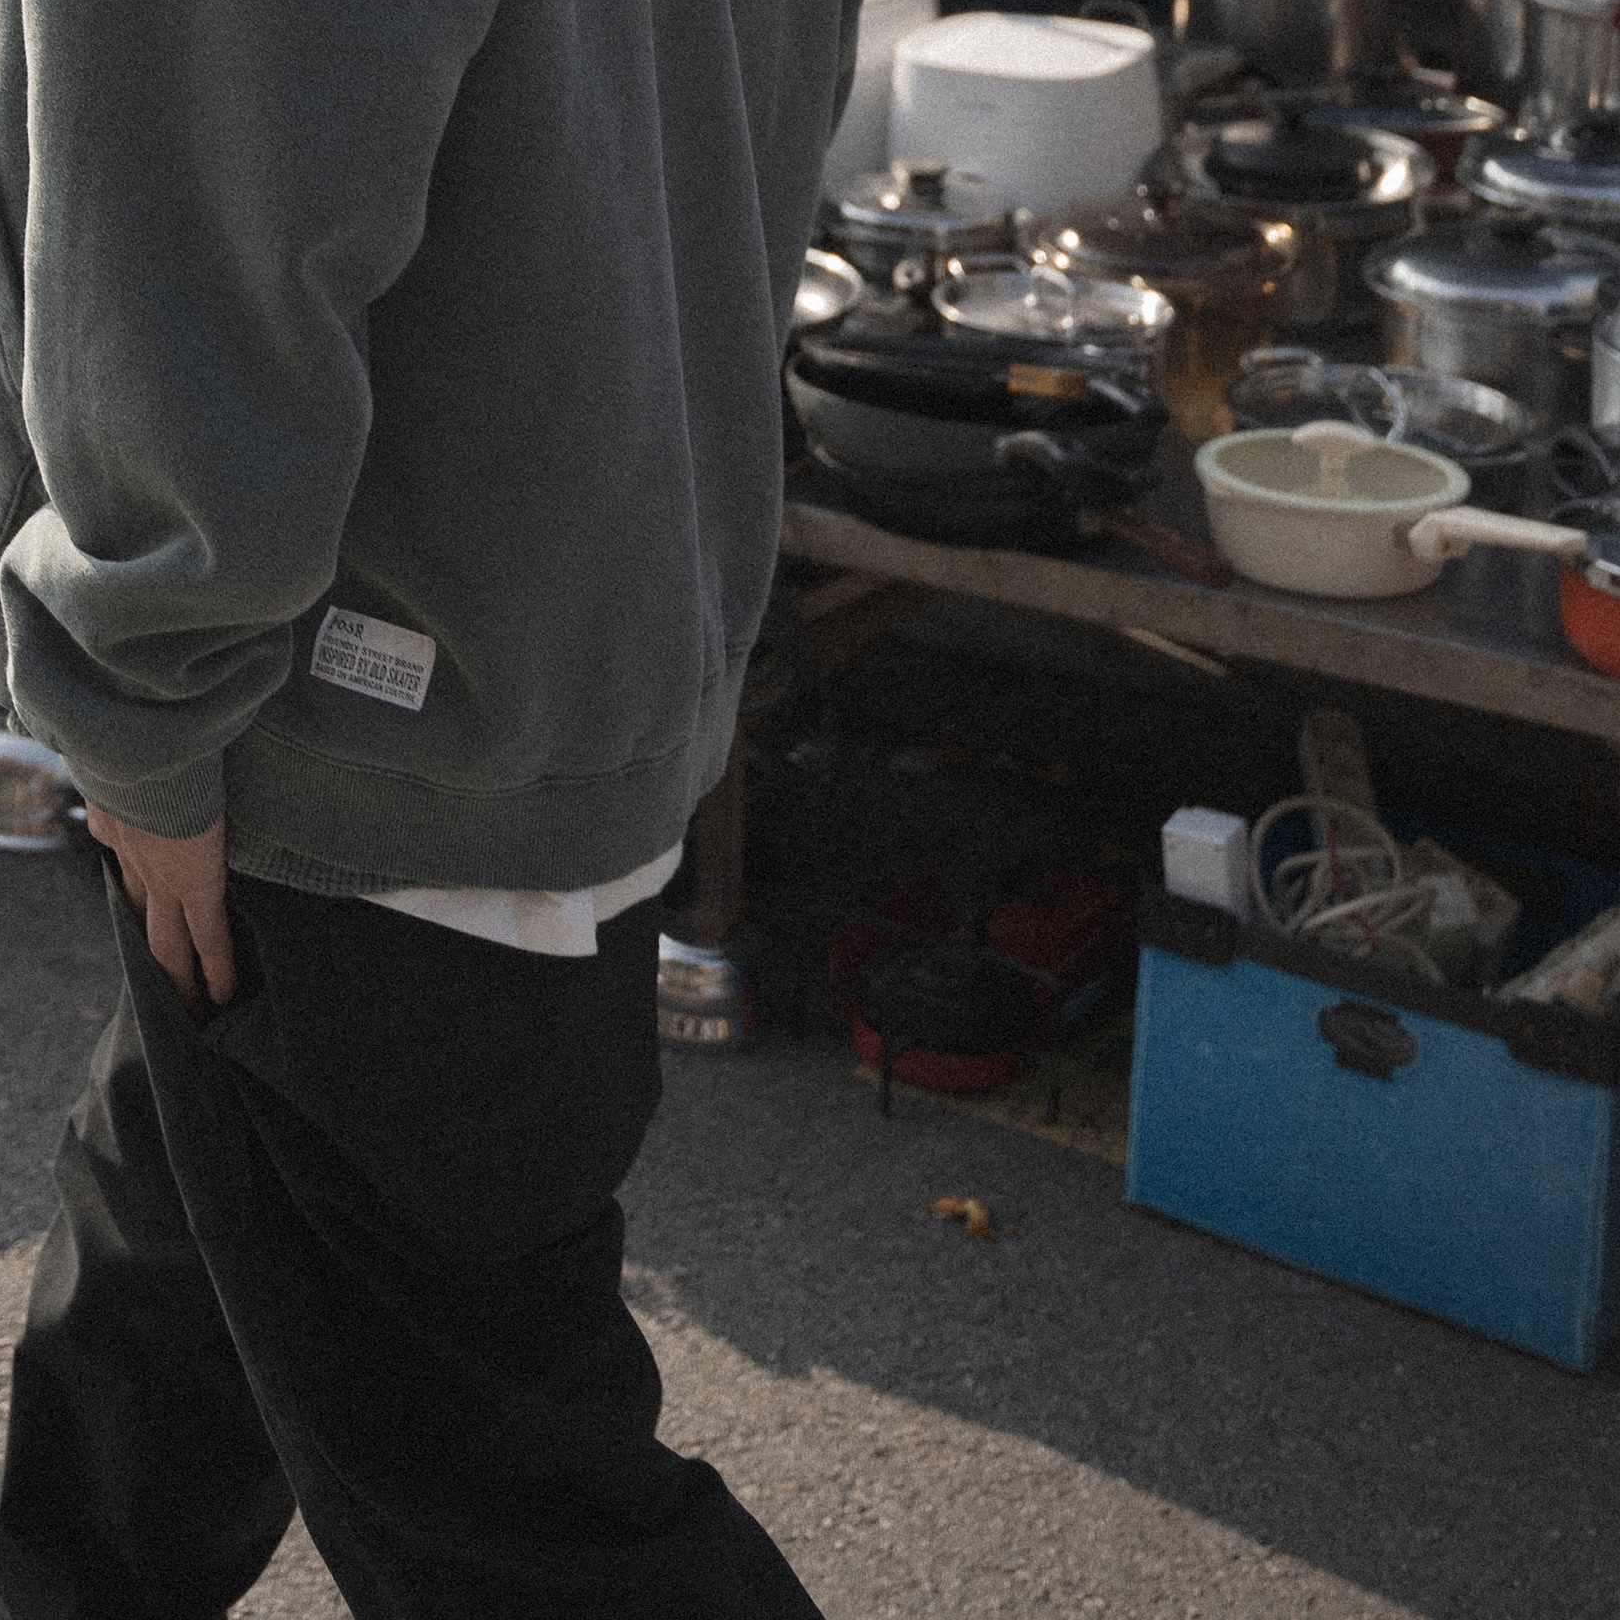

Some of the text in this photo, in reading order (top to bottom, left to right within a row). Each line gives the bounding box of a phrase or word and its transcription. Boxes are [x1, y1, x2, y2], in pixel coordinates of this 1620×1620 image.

[318, 644, 422, 693] INSPIRED BY OLD SKATER
[360, 646, 394, 664] STREET
[394, 657, 425, 674] BRAND
[348, 671, 384, 692] AMERICAN
